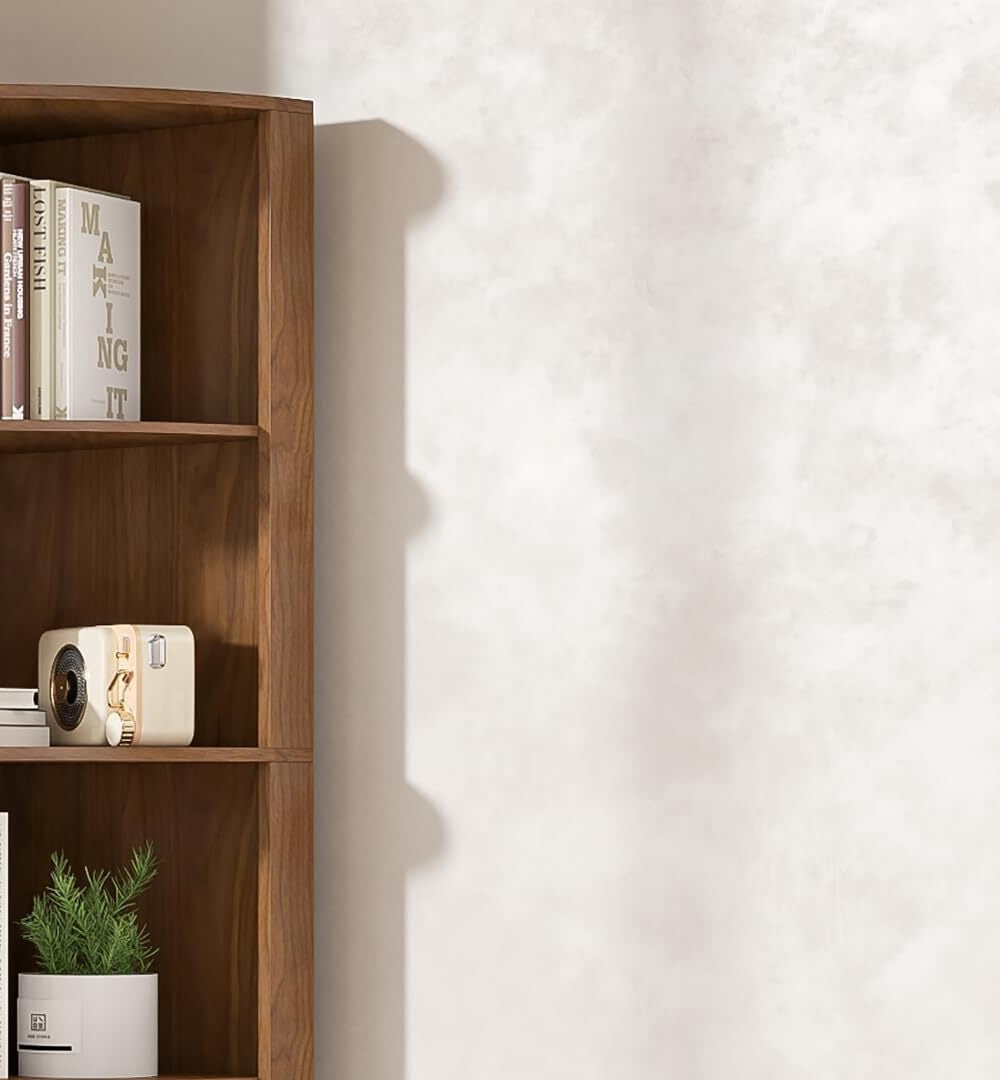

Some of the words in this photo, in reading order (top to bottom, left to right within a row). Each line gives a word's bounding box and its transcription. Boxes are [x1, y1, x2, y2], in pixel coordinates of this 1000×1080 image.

[33, 187, 47, 241] LOST
[33, 246, 47, 291] FISH
[3, 303, 12, 316] in
[106, 386, 128, 420] IT
